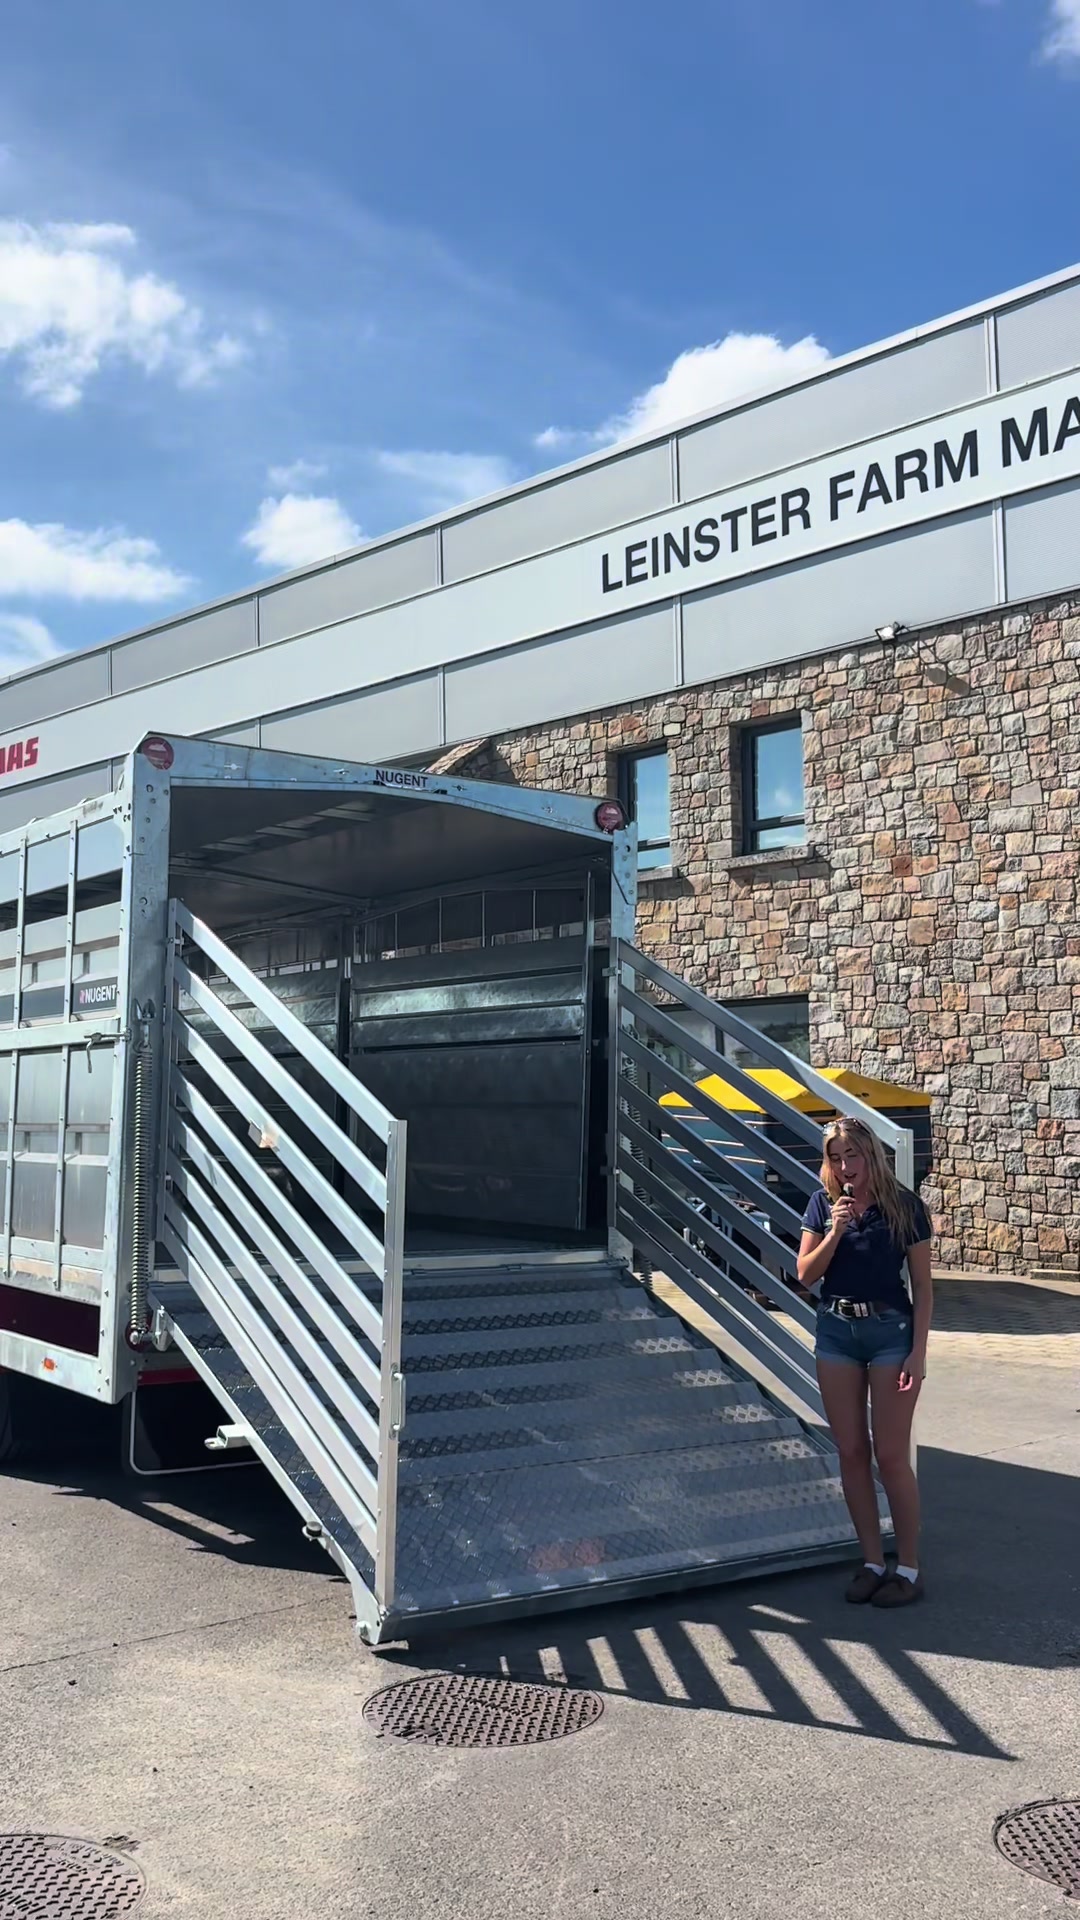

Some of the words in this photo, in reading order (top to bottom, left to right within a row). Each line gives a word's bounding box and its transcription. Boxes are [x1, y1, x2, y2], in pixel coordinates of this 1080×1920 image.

[602, 487, 812, 594] LEINSTER
[829, 429, 979, 522] FARM
[1000, 396, 1080, 468] MA
[375, 769, 428, 788] NUGENT
[85, 984, 117, 1004] NUGENT
